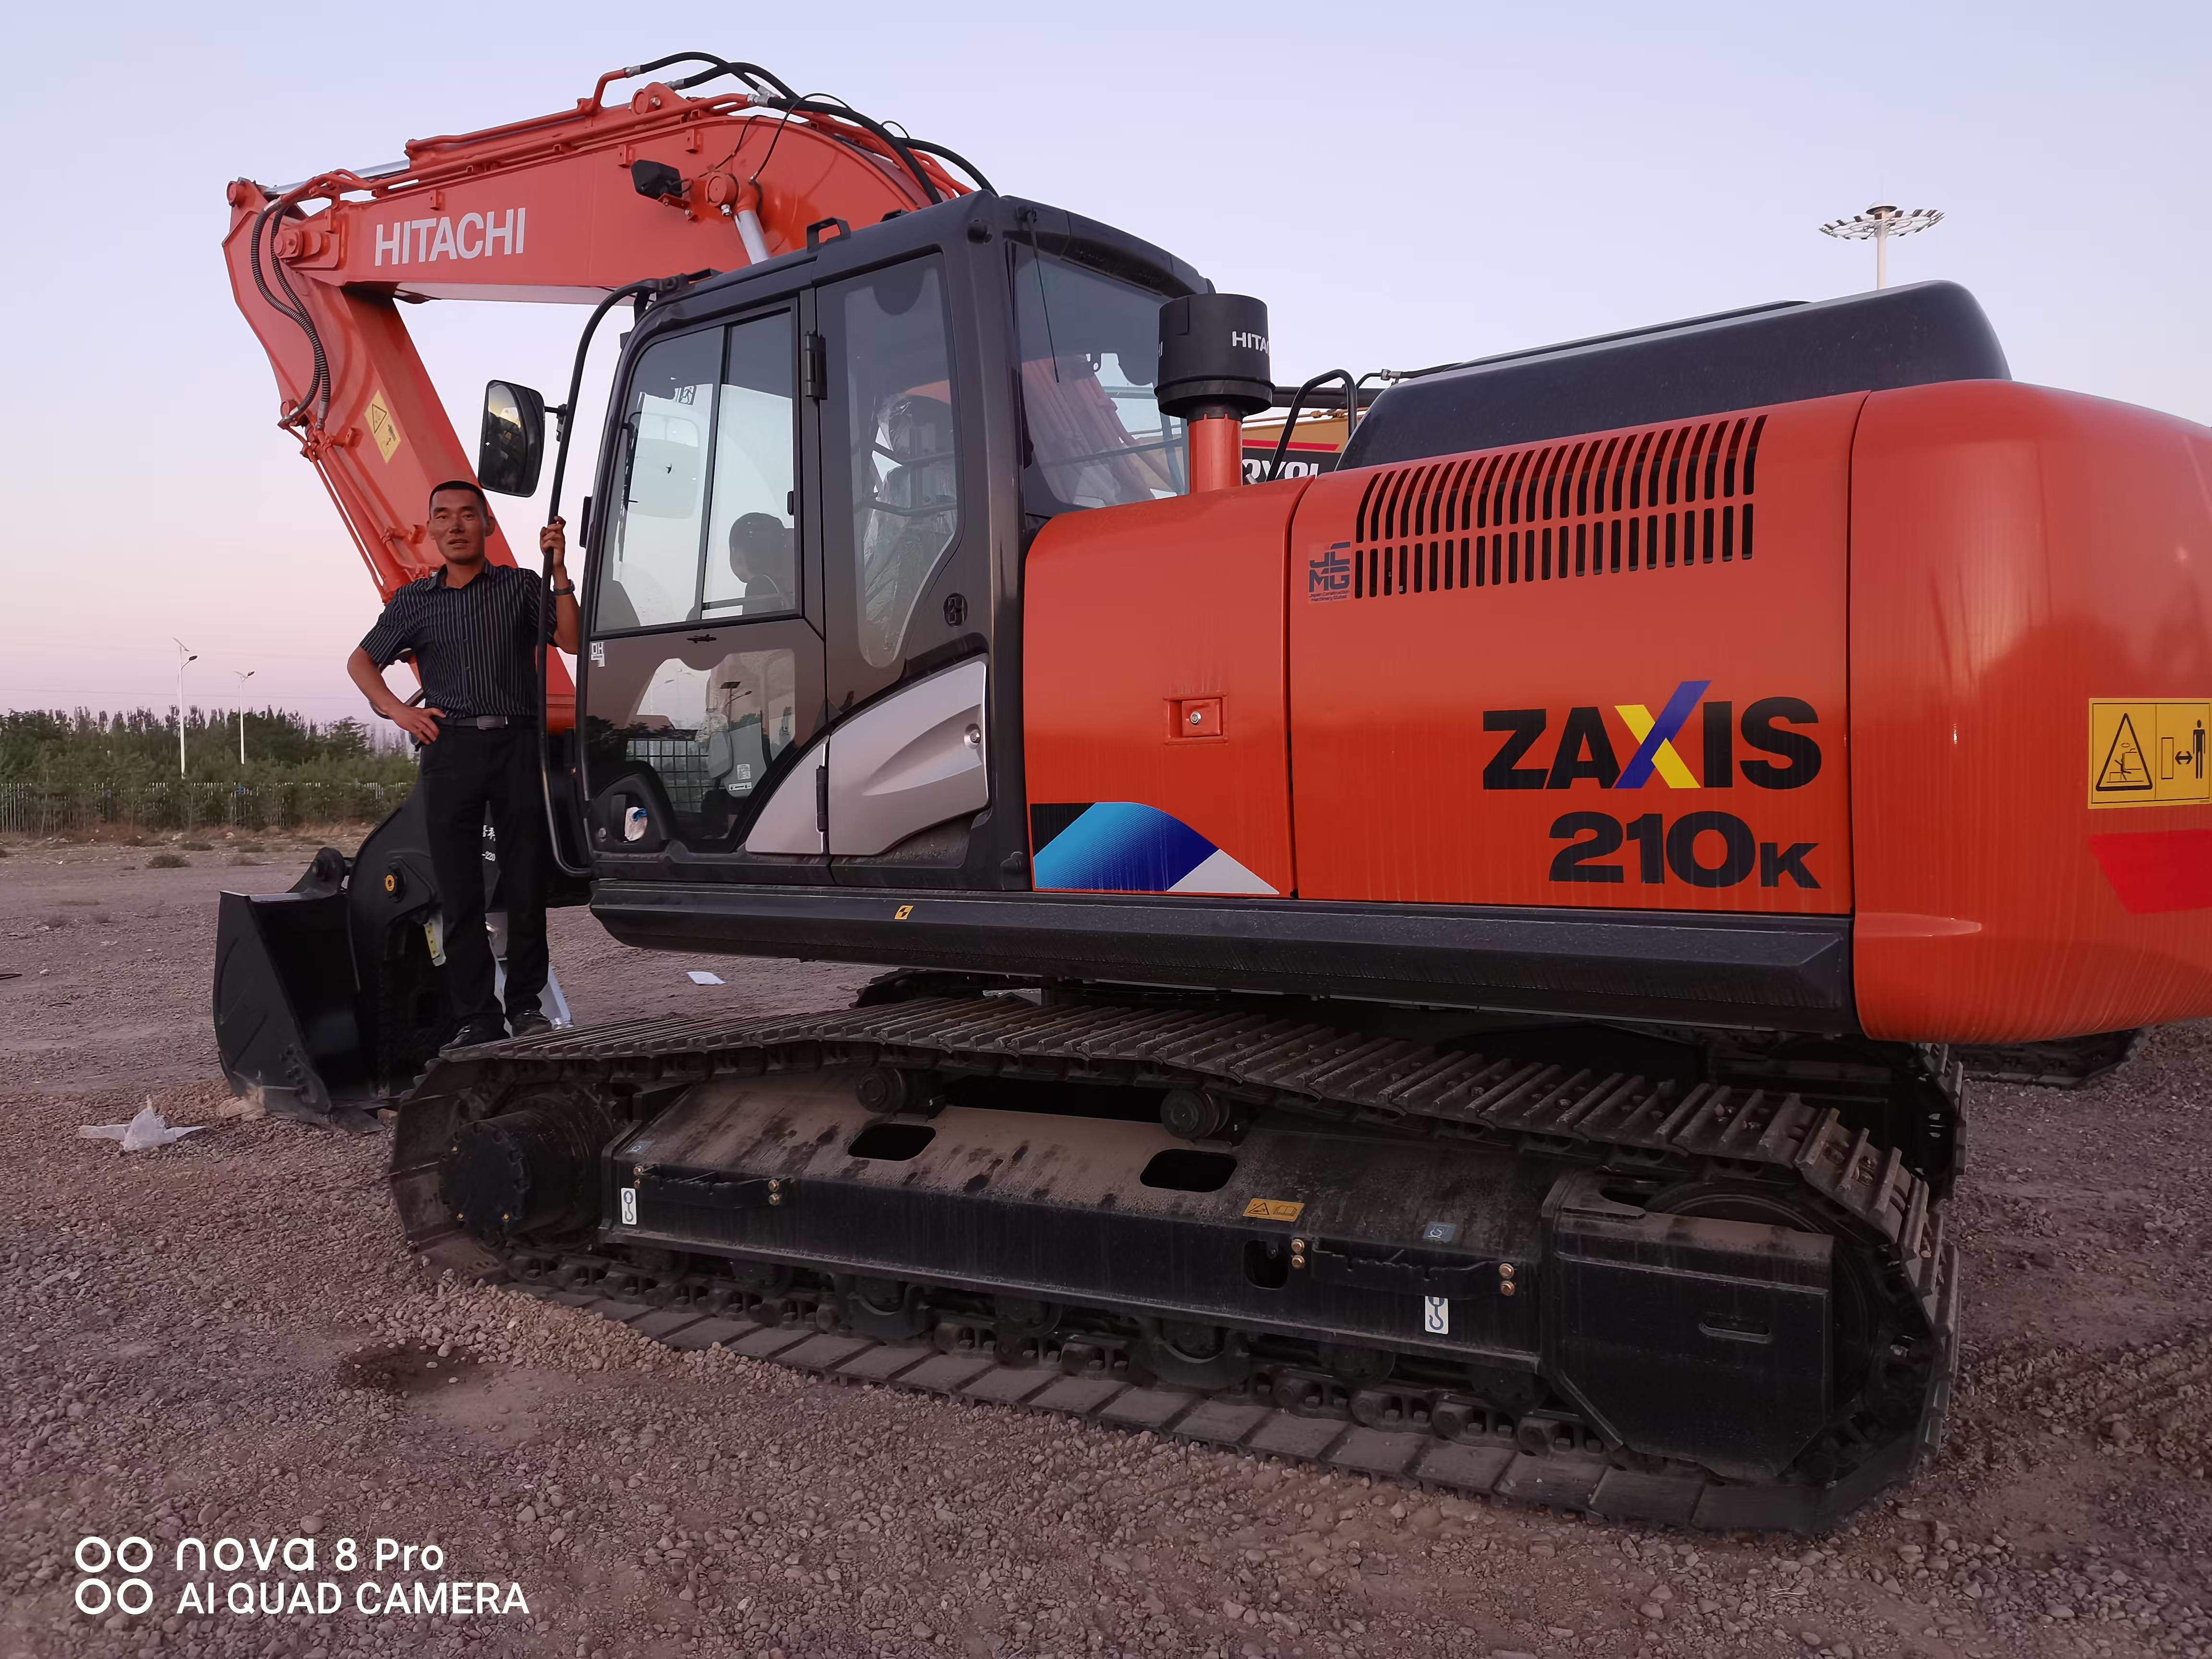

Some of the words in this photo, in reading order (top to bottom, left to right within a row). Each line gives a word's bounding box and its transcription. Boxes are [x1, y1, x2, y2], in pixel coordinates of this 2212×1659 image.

[374, 208, 526, 266] HITACHI
[1232, 331, 1270, 355] HITA
[1483, 680, 1822, 790] ZAXIS
[1549, 811, 1822, 889] 210K
